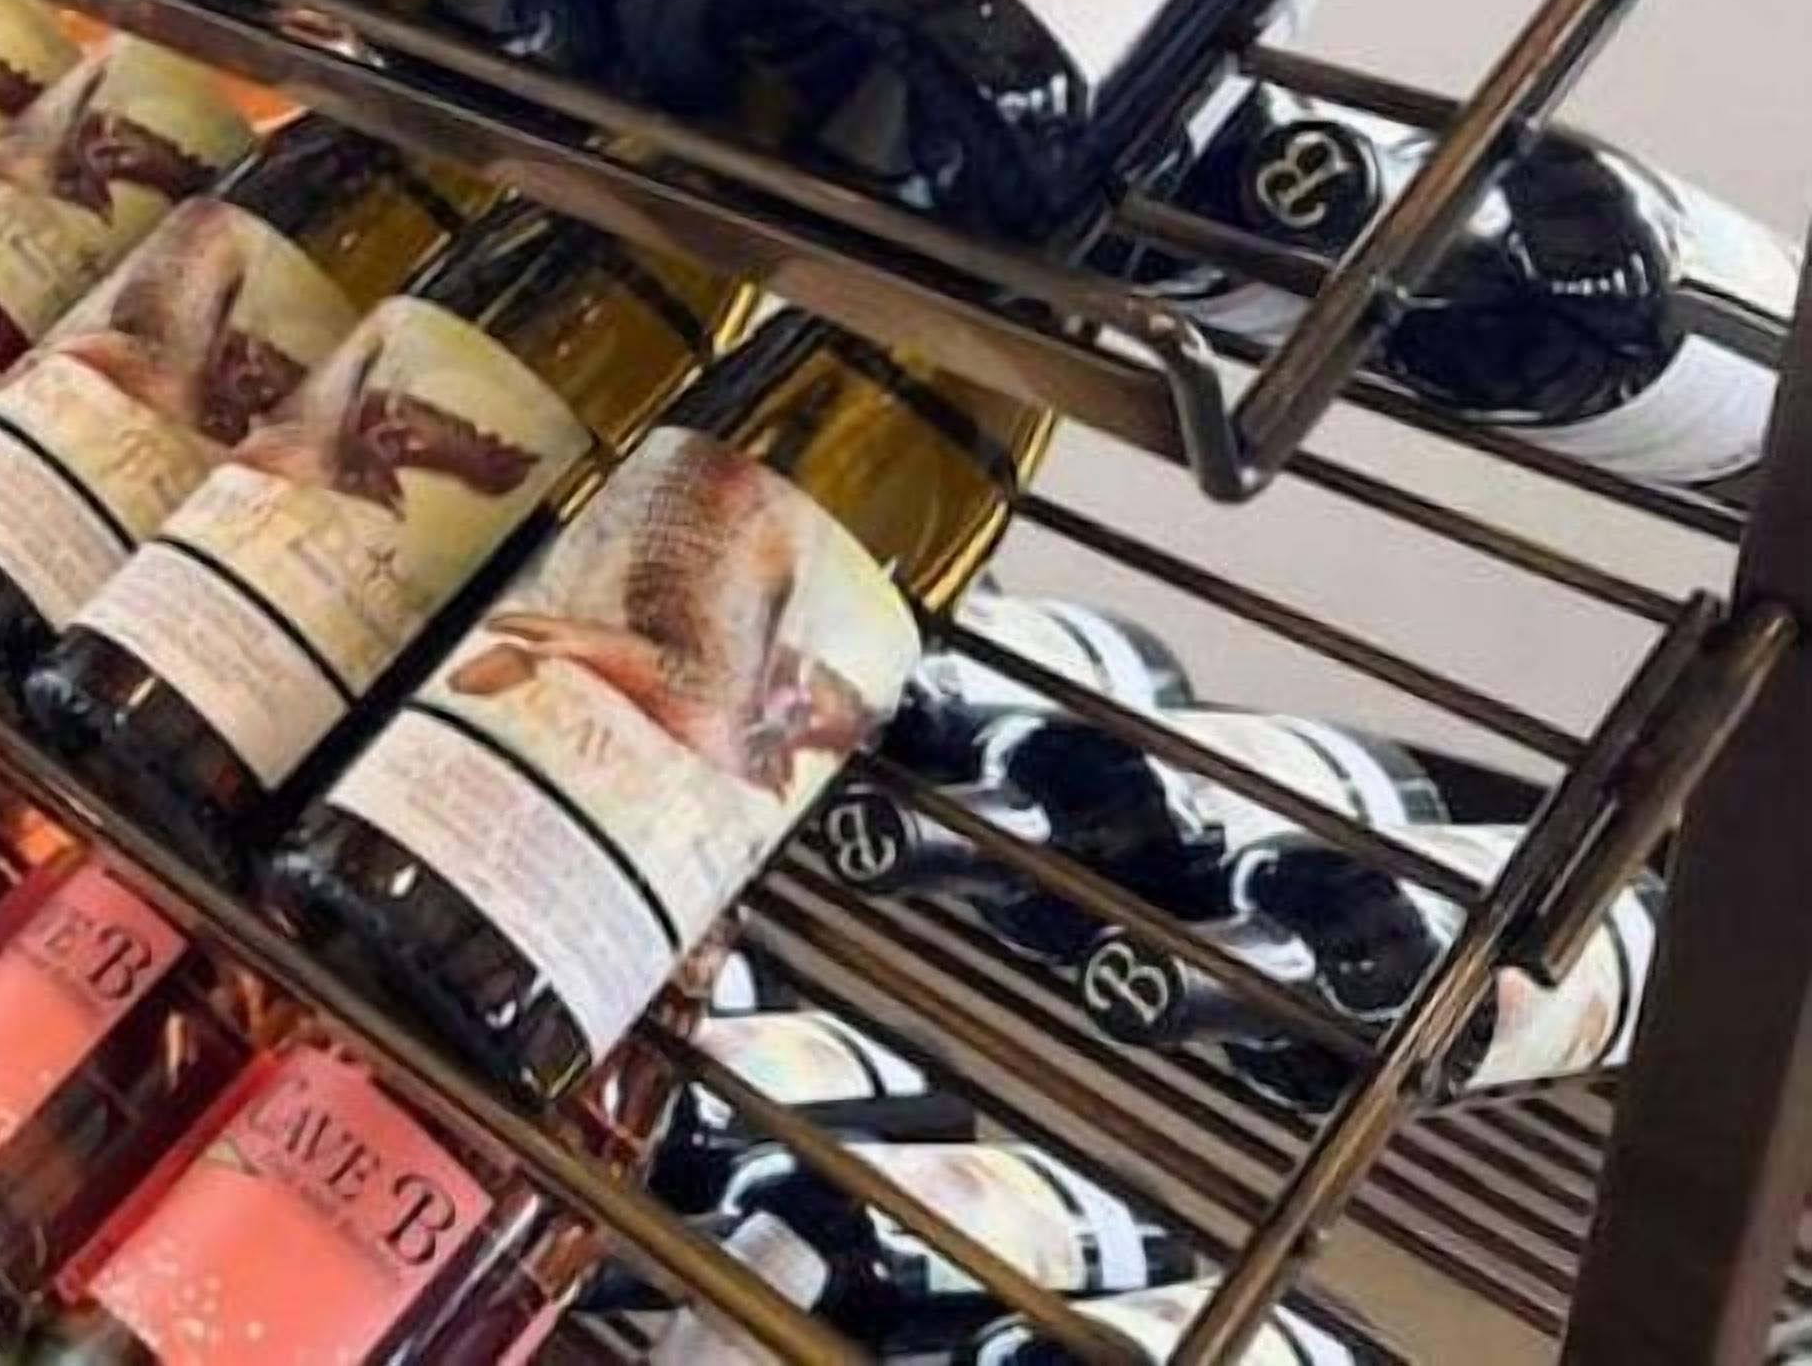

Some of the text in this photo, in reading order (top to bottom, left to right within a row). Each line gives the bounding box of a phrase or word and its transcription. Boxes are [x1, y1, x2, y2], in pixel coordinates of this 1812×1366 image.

[1255, 130, 1355, 228] B
[828, 801, 896, 882] B
[86, 925, 153, 1000] B
[1084, 940, 1169, 1025] B
[387, 1174, 457, 1265] B
